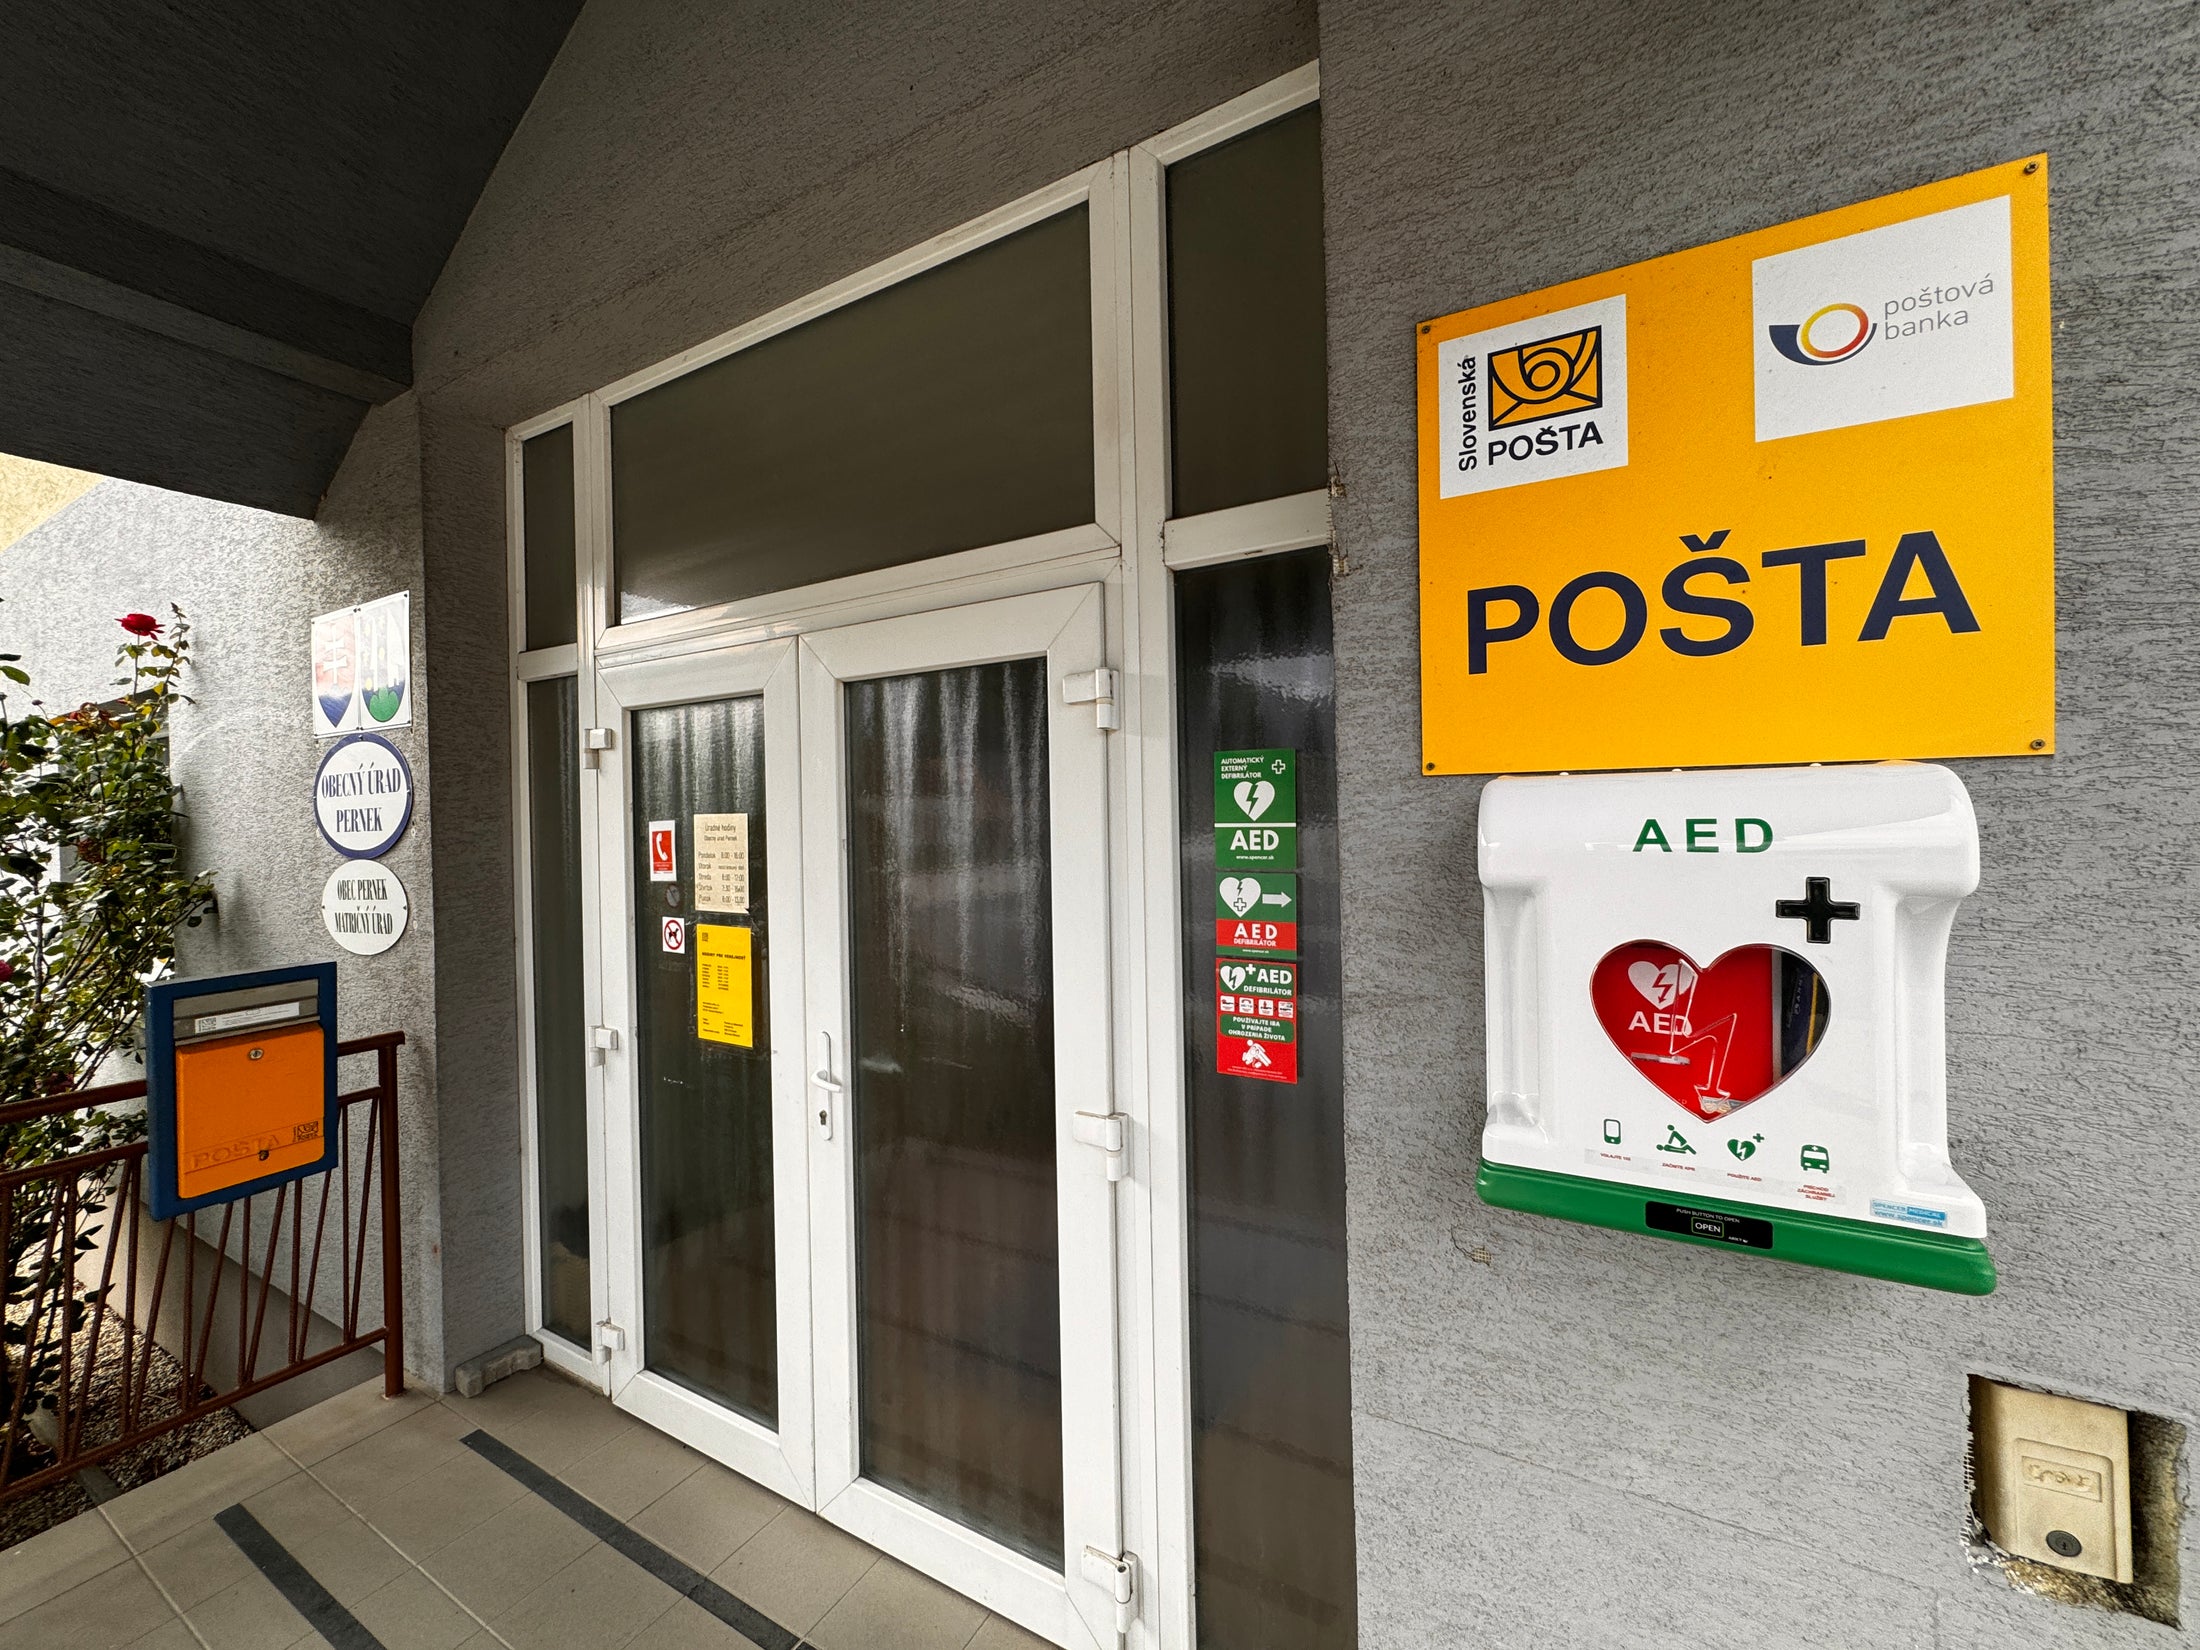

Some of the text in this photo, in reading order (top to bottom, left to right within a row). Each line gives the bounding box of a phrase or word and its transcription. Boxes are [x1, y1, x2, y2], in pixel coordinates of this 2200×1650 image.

[1884, 273, 1995, 320] poštová
[1884, 309, 1970, 341] banka
[1457, 356, 1478, 472] Slovenská
[1488, 420, 1604, 466] POŠTA
[1466, 529, 1982, 675] POŠTA
[1220, 755, 1265, 765] AUTOMATICKÝ
[1220, 764, 1247, 772] EXTERNÝ
[321, 761, 402, 799] OBECNÝ ÚRAD
[1220, 771, 1262, 780] DEFIBRILÁTOR
[336, 807, 383, 833] PERNEK
[1229, 829, 1280, 851] AED
[1632, 818, 1774, 854] AED
[337, 878, 388, 900] OBEC PERNEK
[334, 905, 393, 935] MATRIČNÝ ÚRAD
[1234, 922, 1278, 940] AED
[1233, 937, 1277, 946] DEFIBRILÁTOR
[1256, 968, 1293, 985] AED
[1243, 985, 1293, 996] DEFIBRILÁTOR
[1232, 1016, 1269, 1026] POUŽÍVAJTE
[1246, 1024, 1272, 1033] PRÍPADE
[1628, 1010, 1693, 1036] AED
[1228, 1029, 1286, 1041] OHROZENIA ŽIVOTA
[1692, 1210, 1715, 1219] BUTTON
[1694, 1222, 1722, 1233] OPEN
